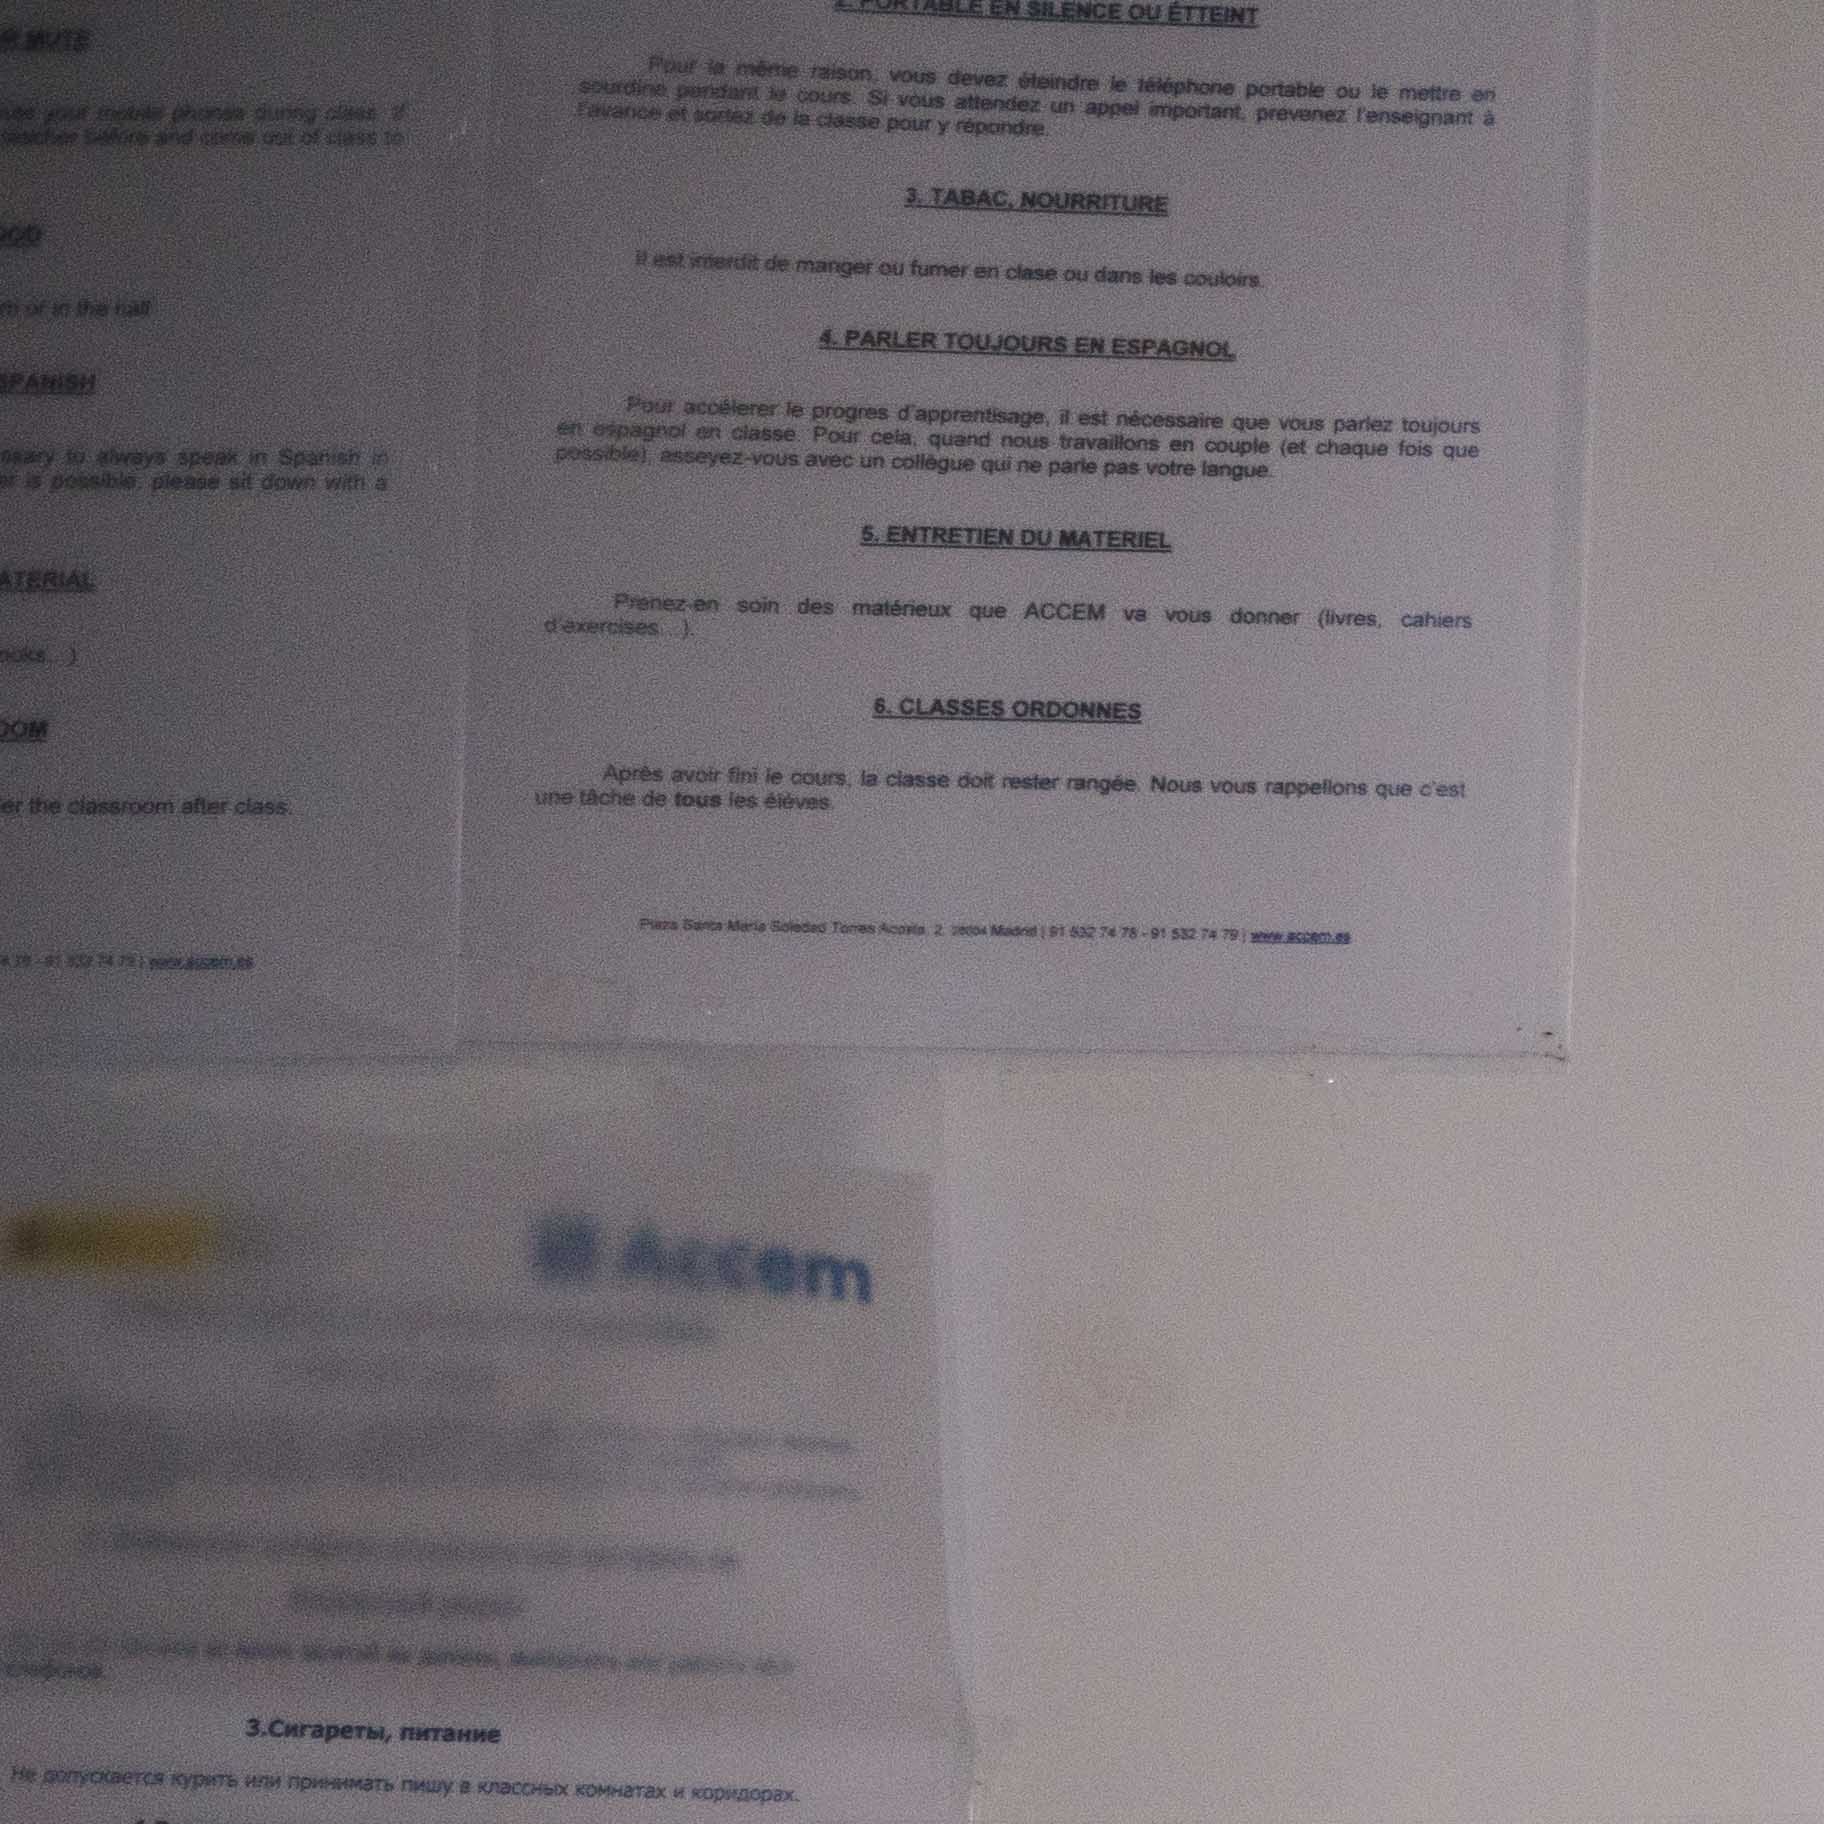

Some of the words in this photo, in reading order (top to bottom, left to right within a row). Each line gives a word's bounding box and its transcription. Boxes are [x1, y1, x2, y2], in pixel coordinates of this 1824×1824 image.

[991, 0, 1021, 19] EN
[1026, 2, 1122, 23] SILENCE
[1128, 4, 1162, 23] OU
[1167, 3, 1260, 26] ÉTTEINT
[906, 185, 925, 206] 3.
[932, 186, 1014, 209] TABAC,
[1020, 190, 1167, 214] NOURRITURE
[818, 328, 838, 350] 4.
[844, 329, 938, 352] PARLER
[944, 332, 1069, 356] TOUJOURS
[1073, 336, 1106, 358] EN
[1110, 338, 1237, 361] ESPAGNOL
[626, 395, 674, 414] Pour
[785, 399, 805, 418] le
[1059, 406, 1071, 426] il
[1076, 407, 1109, 427] est
[1115, 409, 1225, 429] nécessaire
[1231, 415, 1271, 434] que
[1278, 417, 1325, 432] vous
[1401, 416, 1481, 440] toujours
[733, 422, 802, 442] classe.
[813, 424, 859, 444] Pour
[872, 425, 918, 447] cela,
[928, 427, 991, 450] quand
[1001, 433, 1050, 449] nous
[1059, 431, 1160, 451] travaillons
[1169, 437, 1194, 452] en
[1204, 434, 1270, 458] couple
[1316, 437, 1389, 461] chaque
[1398, 439, 1432, 459] fois
[1444, 444, 1478, 463] que
[804, 453, 854, 469] avec
[859, 454, 886, 470] un
[980, 453, 1012, 476] qui
[1016, 458, 1043, 473] ne
[1047, 455, 1099, 478] parle
[1102, 460, 1141, 479] pas
[1145, 457, 1197, 477] votre
[1200, 458, 1276, 482] langue.
[151, 471, 221, 494] please
[229, 471, 253, 491] sit
[261, 472, 316, 491] down
[325, 472, 365, 491] with
[375, 476, 389, 491] a
[861, 524, 879, 545] 5.
[885, 525, 1015, 548] ENTRETIEN
[1019, 528, 1053, 550] DU
[1057, 529, 1173, 553] MATERIEL
[736, 594, 780, 614] soin
[796, 596, 835, 615] des
[968, 604, 1008, 623] que
[1023, 601, 1107, 621] ACCEM
[1122, 607, 1149, 622] va
[1164, 608, 1214, 624] vous
[1228, 605, 1301, 625] donner
[1316, 607, 1381, 631] (livres,
[1400, 609, 1473, 629] cahiers
[872, 696, 890, 717] 6.
[898, 697, 1006, 720] CLASSES
[1011, 700, 1143, 723] ORDONNES
[861, 768, 878, 787] la
[886, 769, 950, 788] classe
[958, 770, 994, 789] doit
[1003, 771, 1058, 790] rester
[1150, 773, 1203, 793] Nous
[1211, 779, 1257, 794] vous
[1376, 782, 1412, 800] que
[29, 796, 62, 815] the
[69, 796, 174, 816] classroom
[181, 797, 227, 816] after
[235, 797, 293, 816] class.
[246, 1718, 393, 1745] 3.Сигареты,
[399, 1726, 502, 1744] питание
[171, 1772, 238, 1792] курить
[245, 1774, 282, 1789] или
[288, 1775, 395, 1796] принимать
[401, 1778, 453, 1797] пишу
[459, 1779, 471, 1794] в
[477, 1780, 568, 1796] классных
[575, 1782, 665, 1799] комнатах
[672, 1784, 685, 1800] и
[691, 1785, 800, 1806] коридорах.
